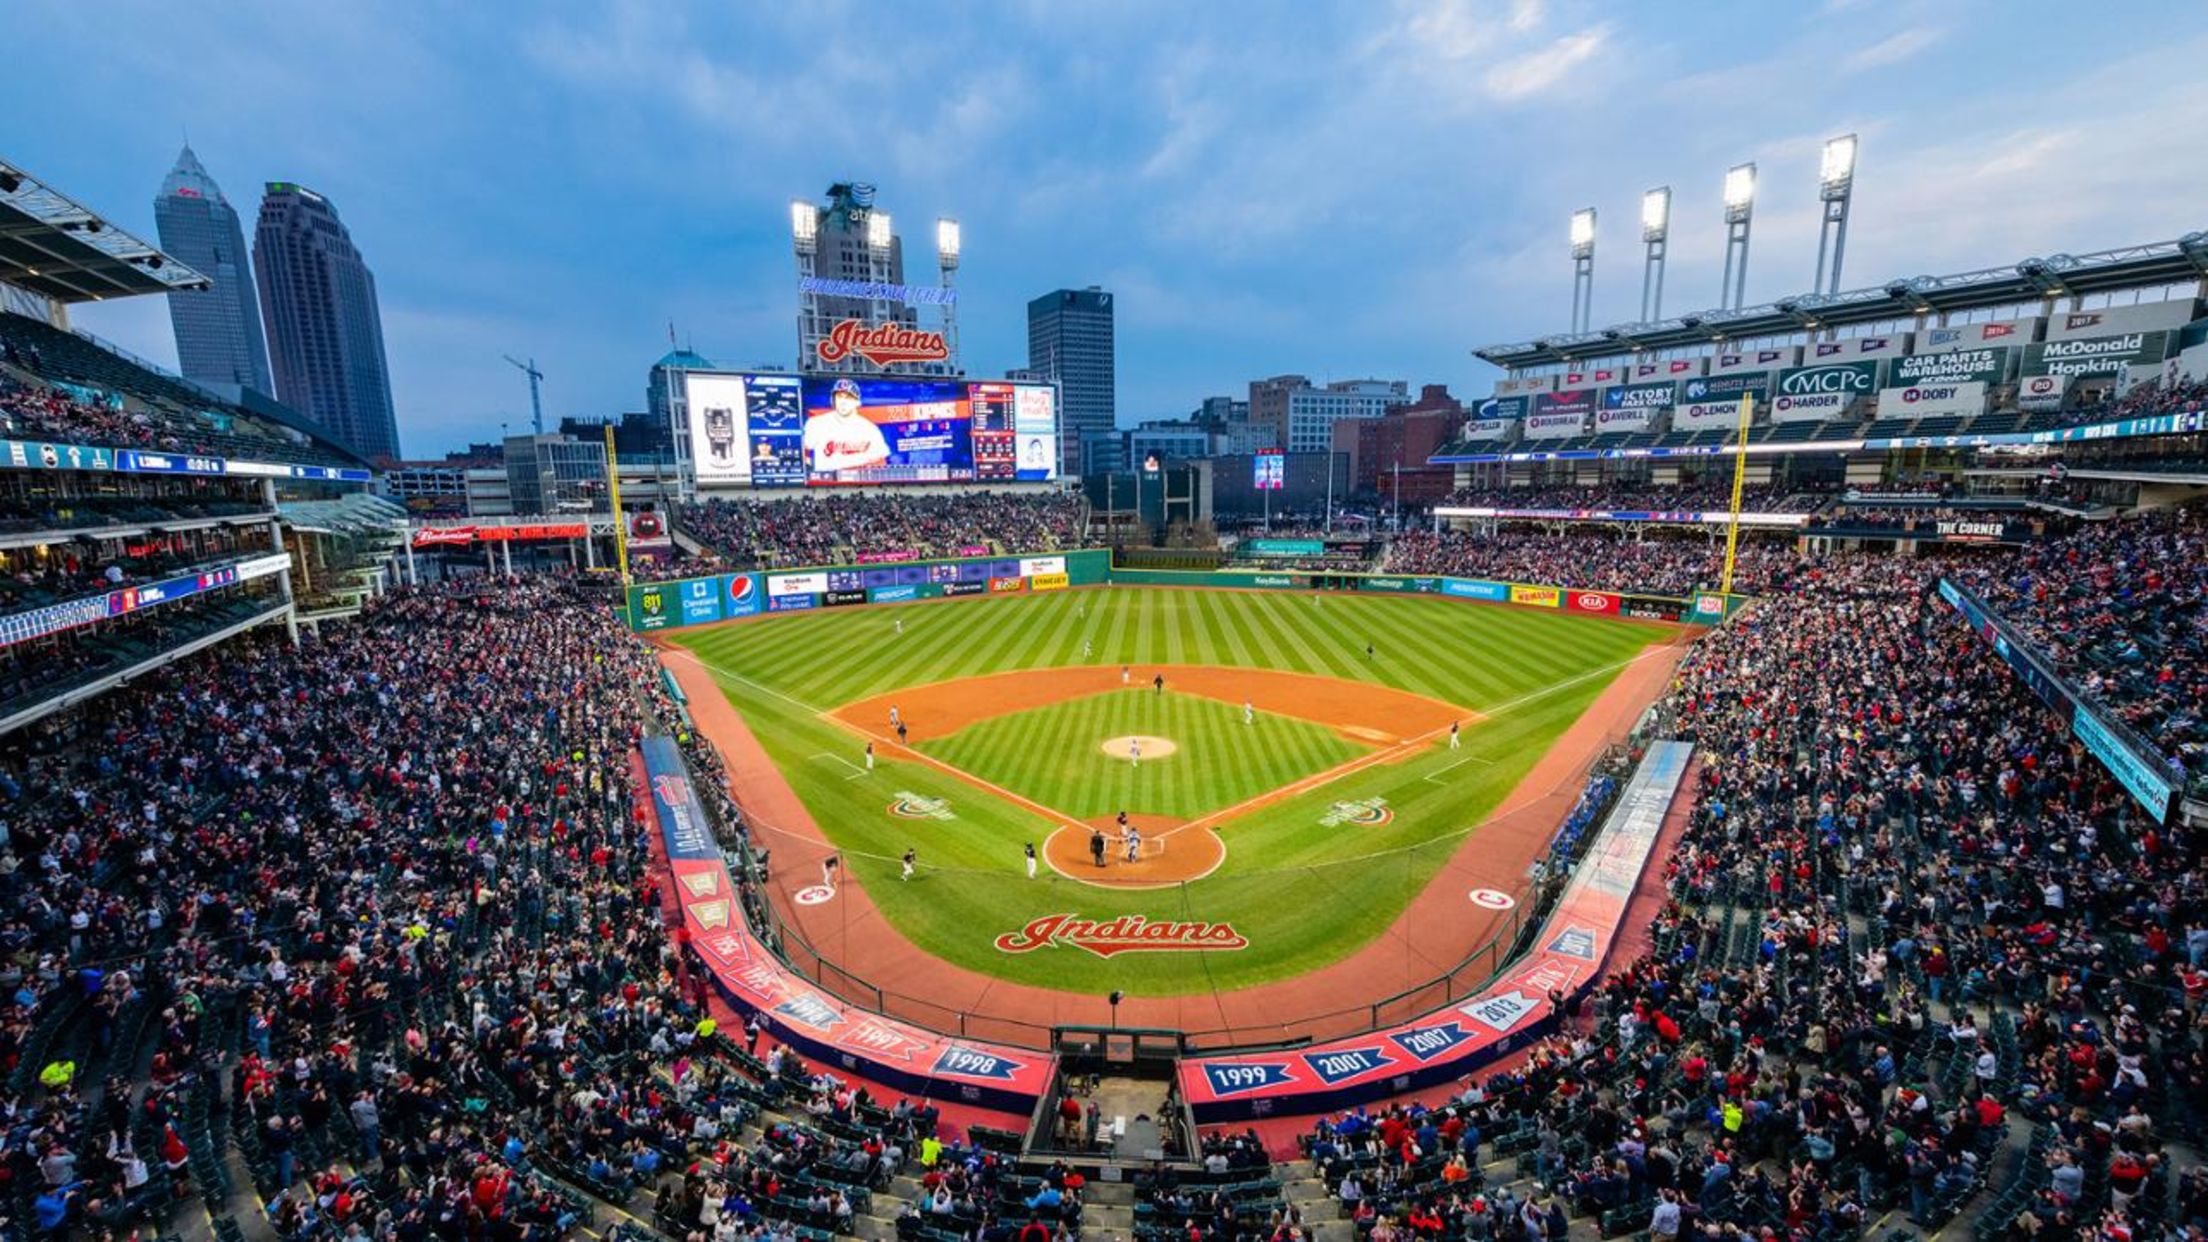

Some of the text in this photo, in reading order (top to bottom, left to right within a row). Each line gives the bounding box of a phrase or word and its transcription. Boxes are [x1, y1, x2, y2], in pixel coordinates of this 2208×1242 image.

[817, 319, 949, 367] Indians
[2043, 334, 2144, 358] McDonald
[1903, 350, 1993, 369] CAR PARTS
[2047, 359, 2129, 377] Hopkins
[1899, 360, 1996, 379] WAREHOUSE
[1922, 387, 1958, 401] DOBY
[2034, 379, 2051, 391] 20
[1703, 404, 1736, 415] LEMON
[1793, 395, 1839, 408] HARDER
[1609, 410, 1645, 422] AVERILL
[418, 531, 472, 541] Budweiser
[1937, 521, 2004, 536] THE CORNER
[642, 593, 663, 608] 811
[683, 596, 719, 608] Cleveland
[1582, 594, 1603, 606] KIA
[691, 606, 713, 617] Clinic
[994, 913, 1250, 960] Indians
[1525, 969, 1566, 991] 2016
[1475, 997, 1522, 1023] 2013
[858, 1024, 903, 1050] 1997
[1404, 1027, 1454, 1053] 2007
[946, 1051, 998, 1074] 1998
[1318, 1051, 1373, 1076] 2001
[1214, 1065, 1268, 1087] 1999
